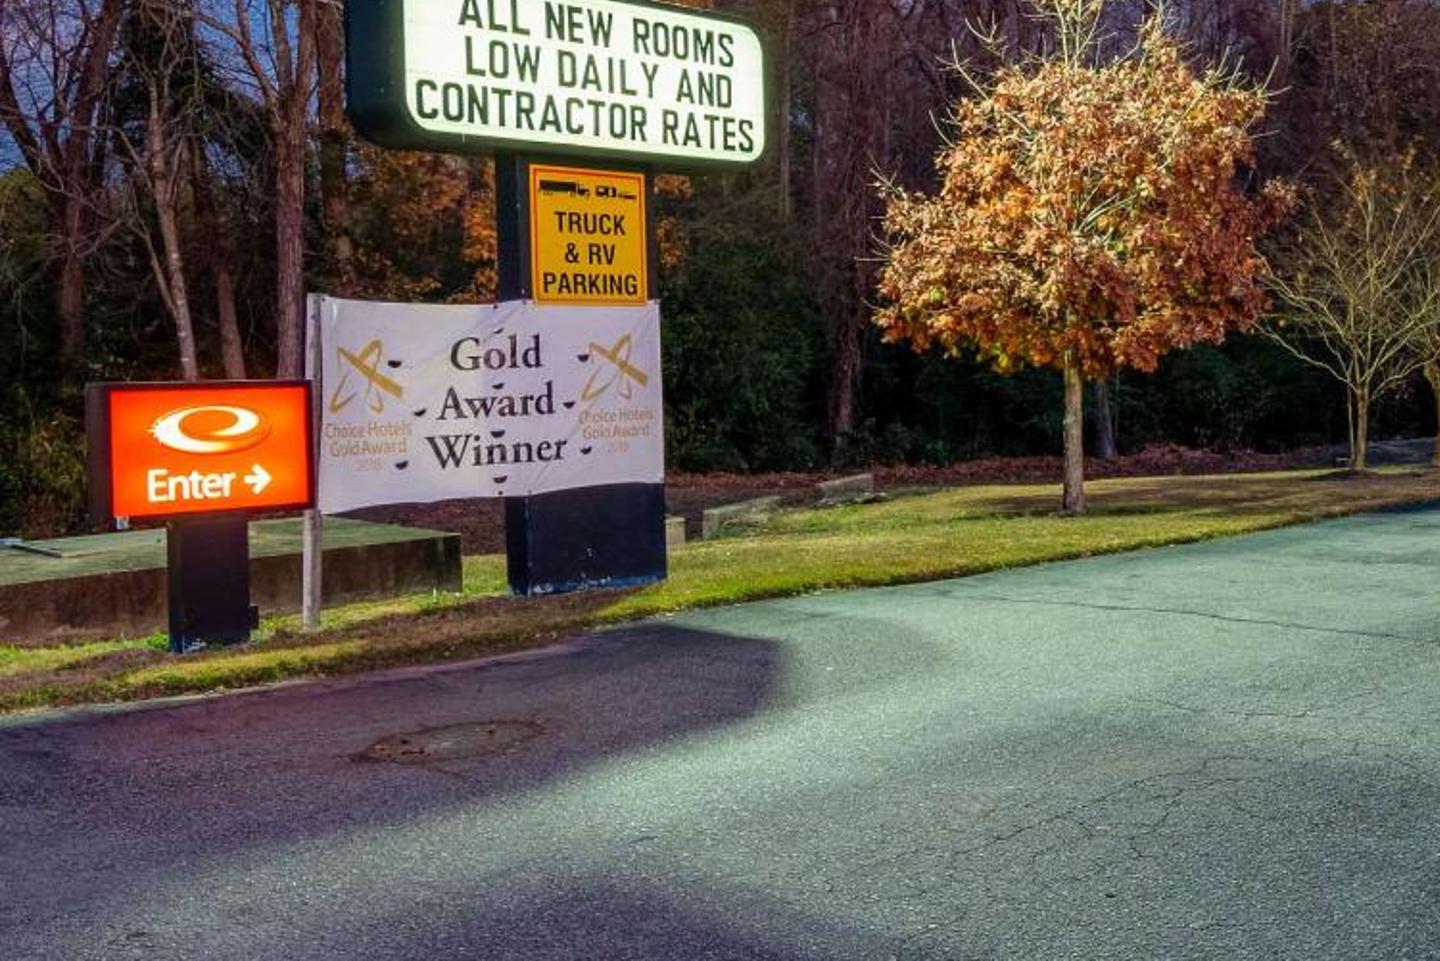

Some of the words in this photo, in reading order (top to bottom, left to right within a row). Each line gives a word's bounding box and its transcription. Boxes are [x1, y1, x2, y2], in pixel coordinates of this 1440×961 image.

[545, 1, 613, 48] NEW
[633, 18, 735, 68] ROOMS
[465, 36, 541, 83] LOW
[558, 49, 659, 98] DAILY
[676, 68, 732, 108] AND
[416, 79, 647, 142] CONTRACTOR
[662, 109, 754, 153] RATES
[554, 211, 625, 235] TRUCK
[565, 242, 579, 263] &
[589, 243, 615, 265] RV
[543, 272, 638, 296] PARKING
[450, 333, 544, 371] Gold
[436, 380, 555, 420] Award
[325, 422, 366, 438] Choice
[367, 420, 412, 437] Hotels
[578, 408, 617, 424] Choice
[583, 425, 611, 439] Gold
[612, 423, 650, 438] Award
[330, 440, 361, 457] Gold
[362, 437, 407, 454] Award
[425, 434, 567, 470] Winner
[147, 468, 237, 502] Enter
